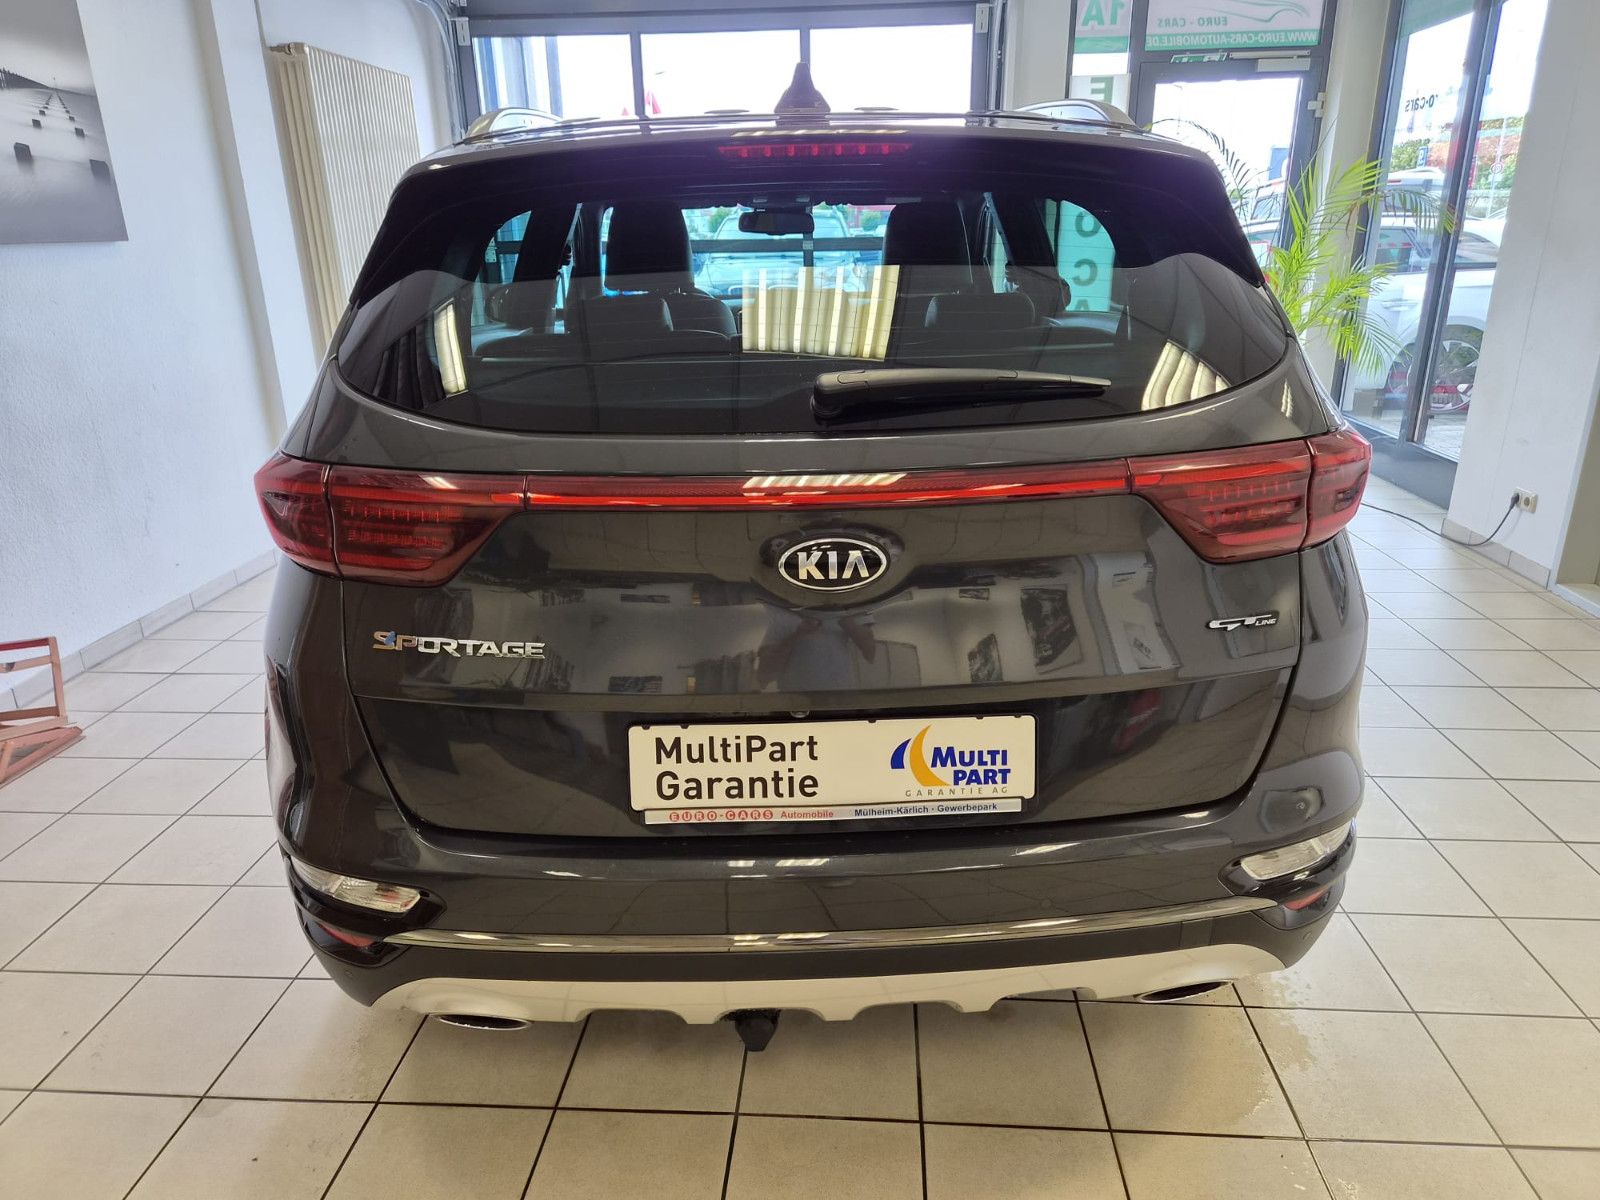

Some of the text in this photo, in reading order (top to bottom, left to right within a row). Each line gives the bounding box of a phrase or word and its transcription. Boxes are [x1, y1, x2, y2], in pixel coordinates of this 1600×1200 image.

[797, 550, 869, 580] KIA
[372, 630, 546, 659] SPORTAGE
[655, 735, 818, 765] MultiPart
[930, 746, 1008, 768] MULTI
[656, 768, 819, 801] Garantie
[953, 768, 1011, 786] PART
[905, 786, 1009, 798] GARANTIE AG
[669, 809, 774, 822] EURO-CARS
[780, 809, 834, 819] Automobile
[854, 804, 929, 816] Mülheim-Kärlich
[937, 803, 998, 813] Gewerbepark
